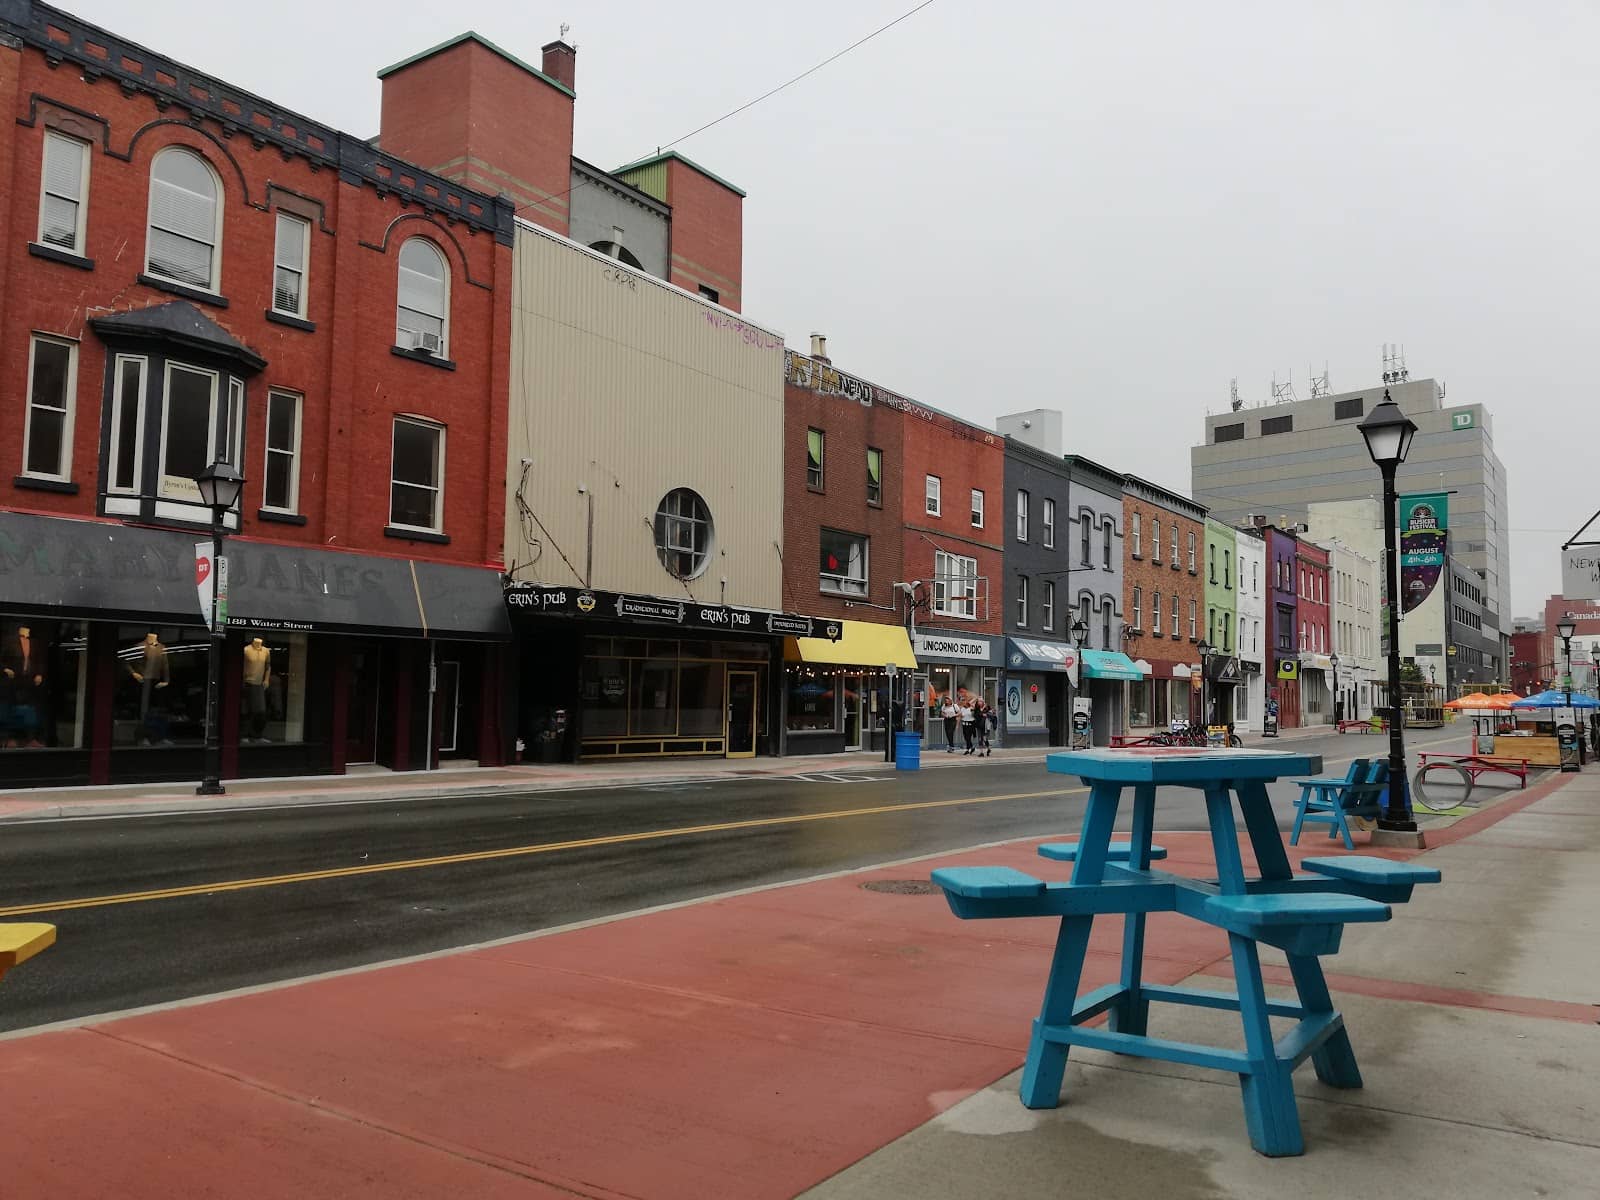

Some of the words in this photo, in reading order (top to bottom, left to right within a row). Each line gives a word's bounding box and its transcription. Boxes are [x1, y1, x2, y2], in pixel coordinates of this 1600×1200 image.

[1453, 413, 1472, 426] TD
[1408, 547, 1439, 555] AUGUST
[1569, 557, 1600, 569] NEW
[227, 617, 247, 625] 188
[250, 618, 281, 628] Water
[283, 621, 313, 630] Street
[923, 641, 958, 653] UNICORNIO
[959, 644, 982, 655] STUDIO
